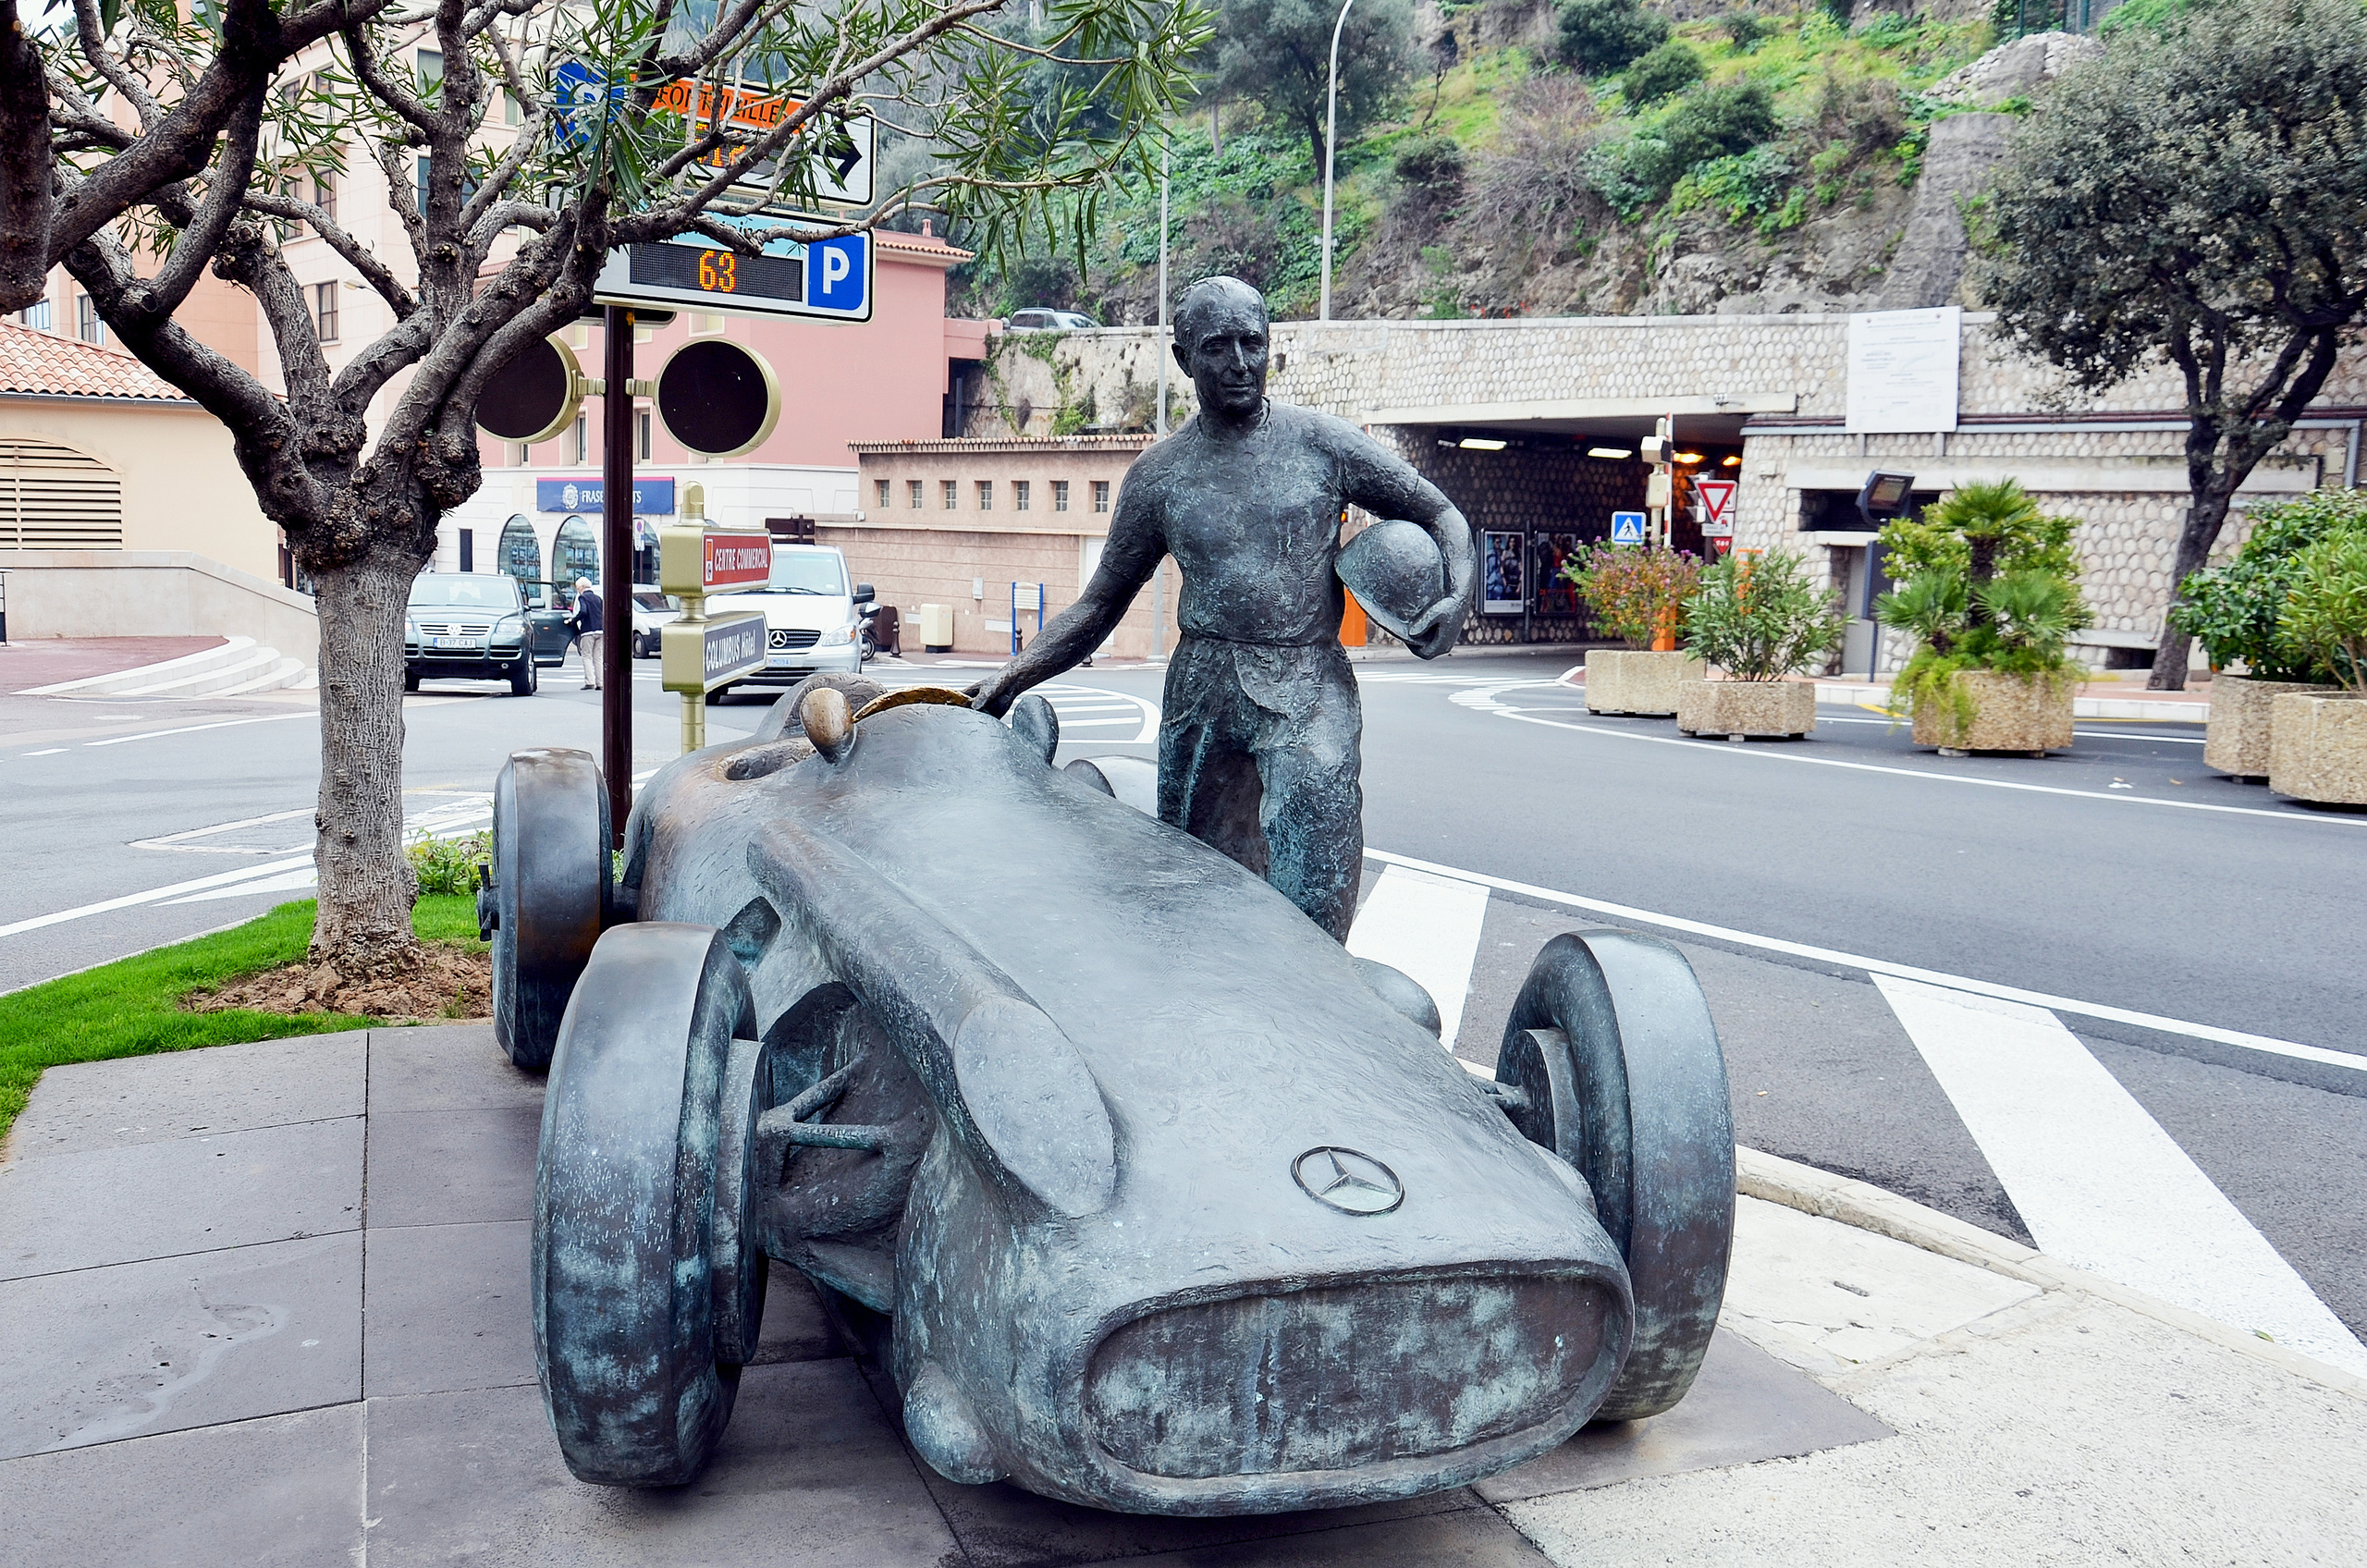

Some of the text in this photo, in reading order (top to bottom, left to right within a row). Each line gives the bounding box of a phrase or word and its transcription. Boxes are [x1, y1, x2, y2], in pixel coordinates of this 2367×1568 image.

[657, 86, 780, 123] FOTIILLE
[699, 250, 736, 293] 63
[823, 246, 850, 294] P
[582, 490, 604, 503] FRASE
[715, 547, 767, 571] CENTRE COMMERCIAL
[705, 629, 756, 672] COLUMBUS Hôtel
